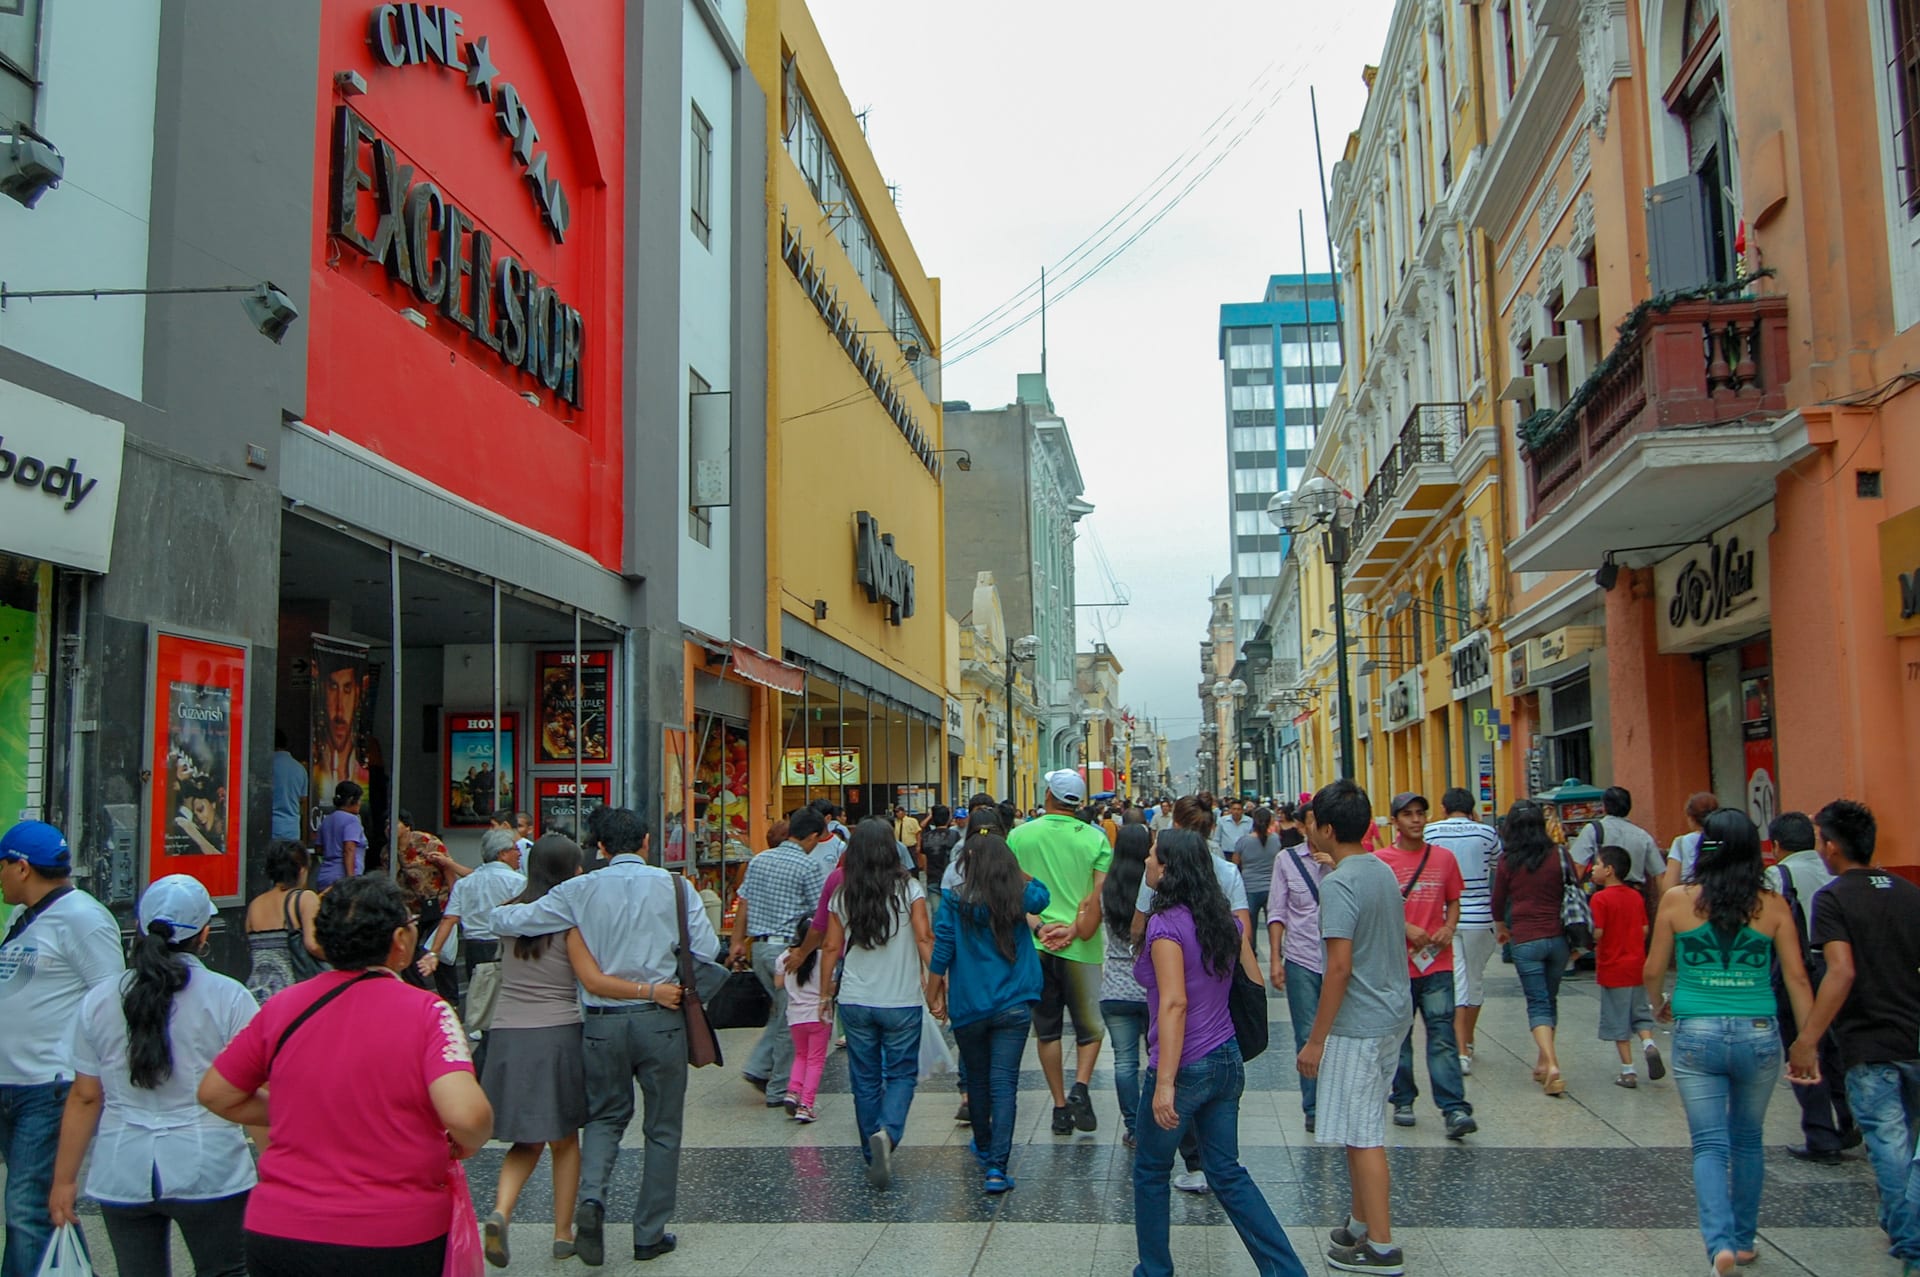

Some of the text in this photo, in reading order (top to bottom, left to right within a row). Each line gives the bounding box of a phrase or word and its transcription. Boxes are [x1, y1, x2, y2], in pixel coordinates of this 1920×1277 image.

[370, 2, 570, 244] CINE STAR
[330, 105, 585, 411] EXCELSIOR
[467, 744, 494, 756] CAS
